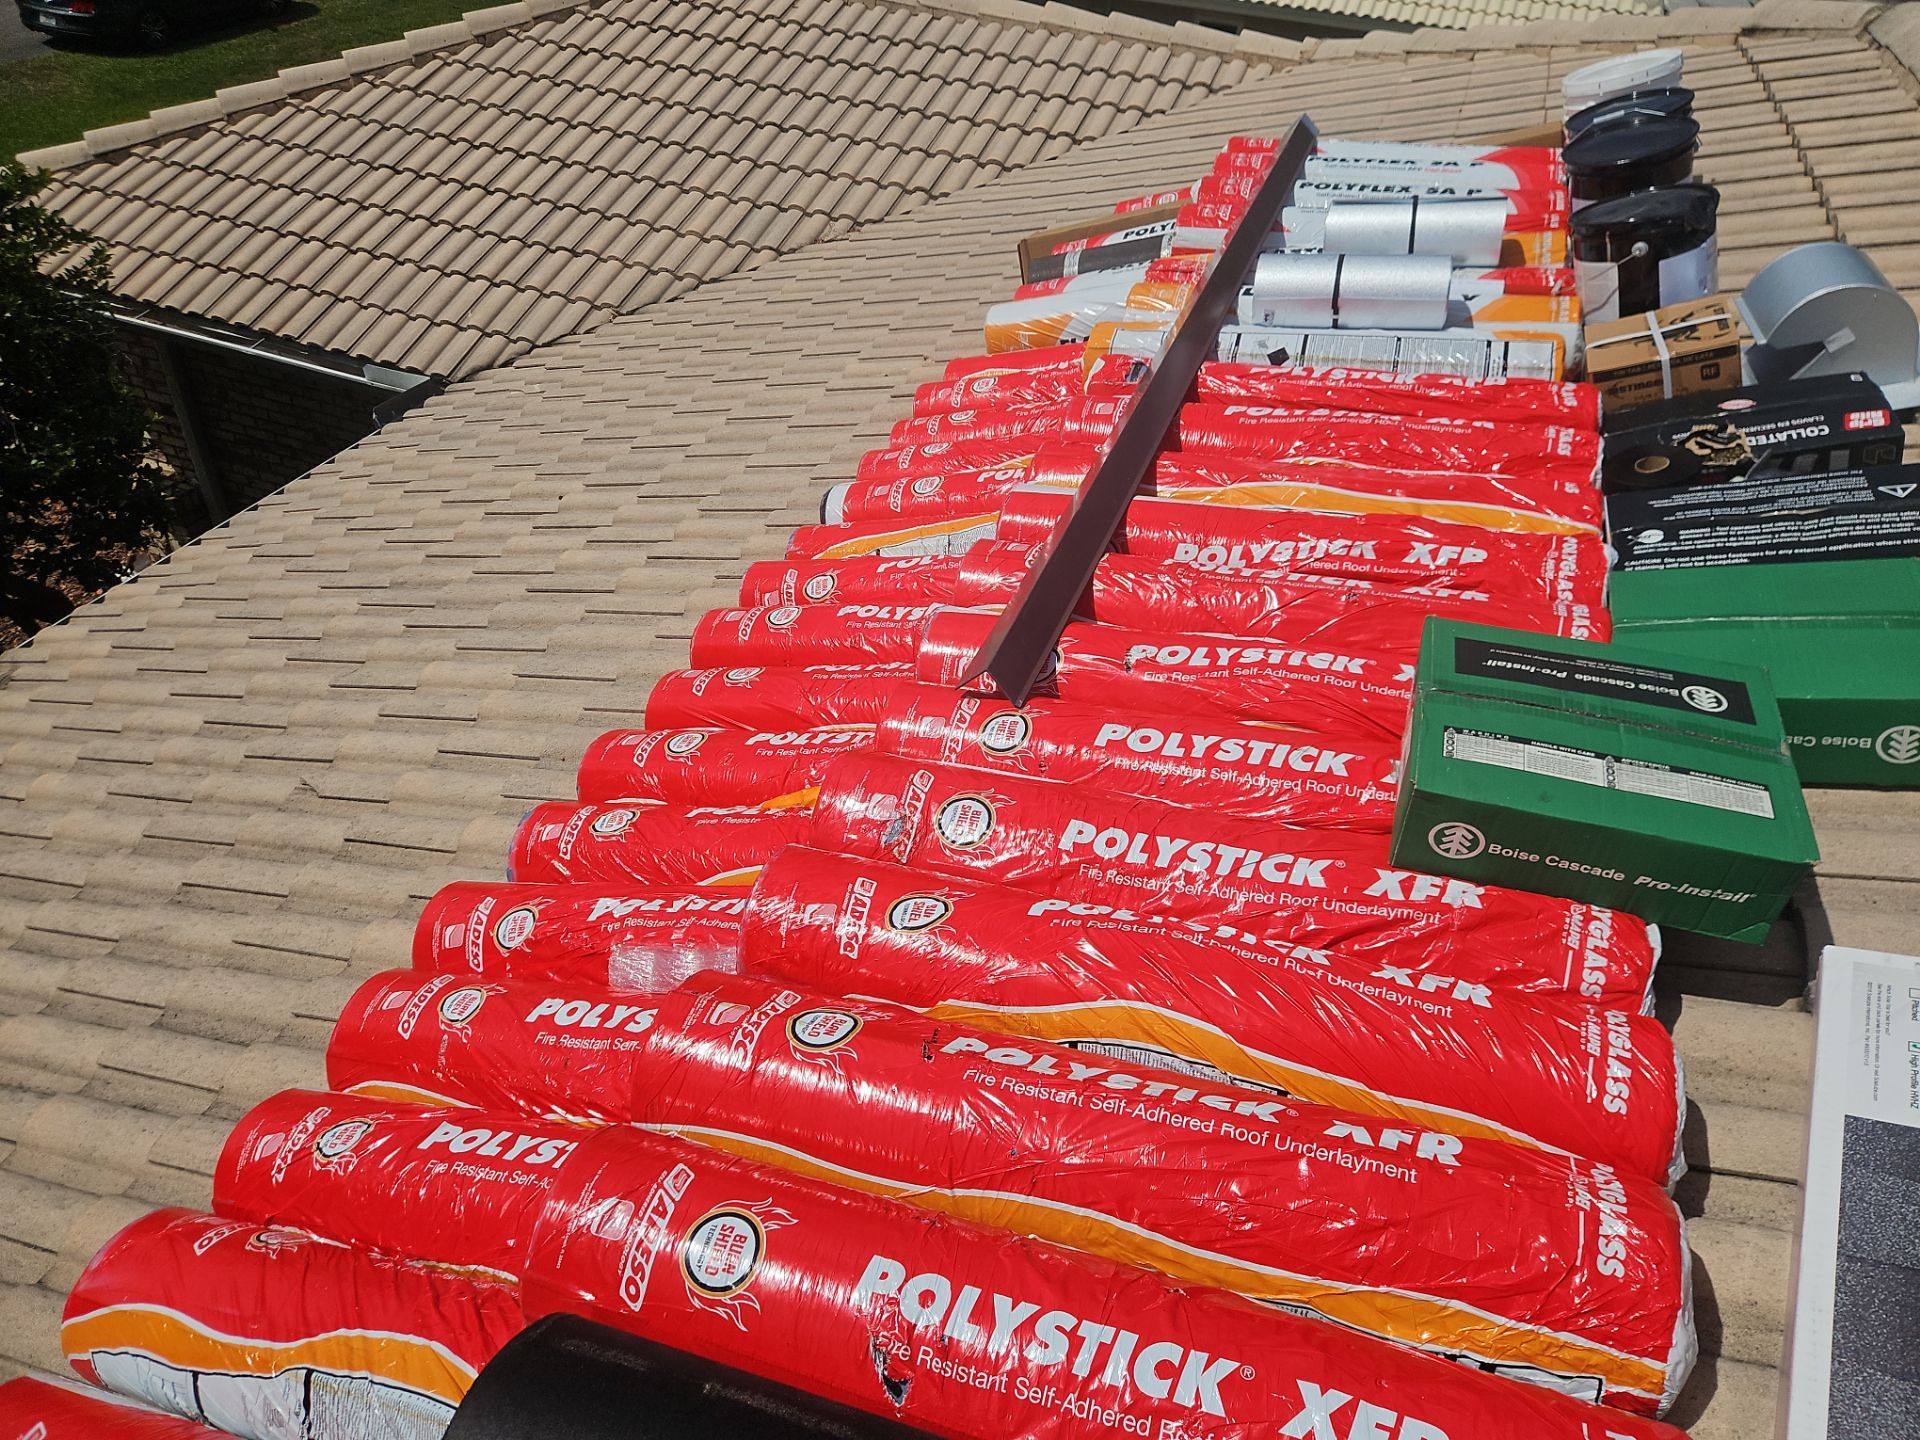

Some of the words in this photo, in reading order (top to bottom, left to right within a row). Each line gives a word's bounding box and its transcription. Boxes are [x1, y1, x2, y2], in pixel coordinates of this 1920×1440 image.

[1299, 181, 1413, 193] POLYFLEX
[1172, 539, 1380, 569] POLYSTICK
[1342, 562, 1370, 573] Roof
[846, 621, 861, 629] Fire
[864, 621, 901, 629] Resistant
[1128, 644, 1369, 675] POLYSTICK
[1233, 666, 1321, 684] Self-Adhered
[1323, 675, 1356, 689] Roof
[1574, 672, 1636, 690] Cascade
[1638, 682, 1680, 697] Boise
[755, 748, 774, 756] Fire
[1093, 722, 1356, 777] POLYSTICK
[1821, 735, 1872, 748] Boise
[1210, 766, 1302, 792] Self-Adhered
[1305, 779, 1342, 795] Roof
[1363, 867, 1489, 910] XFR
[1488, 843, 1541, 862] Boise
[1545, 854, 1627, 882] Cascade
[1634, 875, 1752, 903] Pro-Install
[1079, 863, 1101, 880] Fire
[1105, 869, 1172, 895] Resistant
[1174, 879, 1276, 906] Self-Adhered
[1279, 892, 1319, 907] Roof
[1322, 896, 1443, 925] Underlayment
[624, 917, 678, 930] Resistant
[469, 912, 487, 973] ADESO
[1327, 972, 1453, 1018] Underlayment
[1369, 963, 1493, 1008] XFR
[399, 983, 443, 1038] ADESO
[524, 997, 660, 1033] POLYS
[534, 1031, 555, 1045] Fire
[559, 1034, 612, 1051] Resistant
[963, 1069, 996, 1087] Fire
[1000, 1077, 1084, 1107] Resistant
[1089, 1095, 1215, 1134] Self-Adhered
[1220, 1122, 1269, 1147] Roof
[1274, 1133, 1418, 1184] Underlayment
[424, 1159, 447, 1175] Fire
[450, 1161, 509, 1184] Resistant
[620, 1190, 673, 1310] ADESO
[705, 1223, 735, 1277] SHIELD
[722, 1234, 748, 1277] BURN
[916, 1345, 1009, 1394] Resistant
[1014, 1376, 1152, 1437] Self-Adhered
